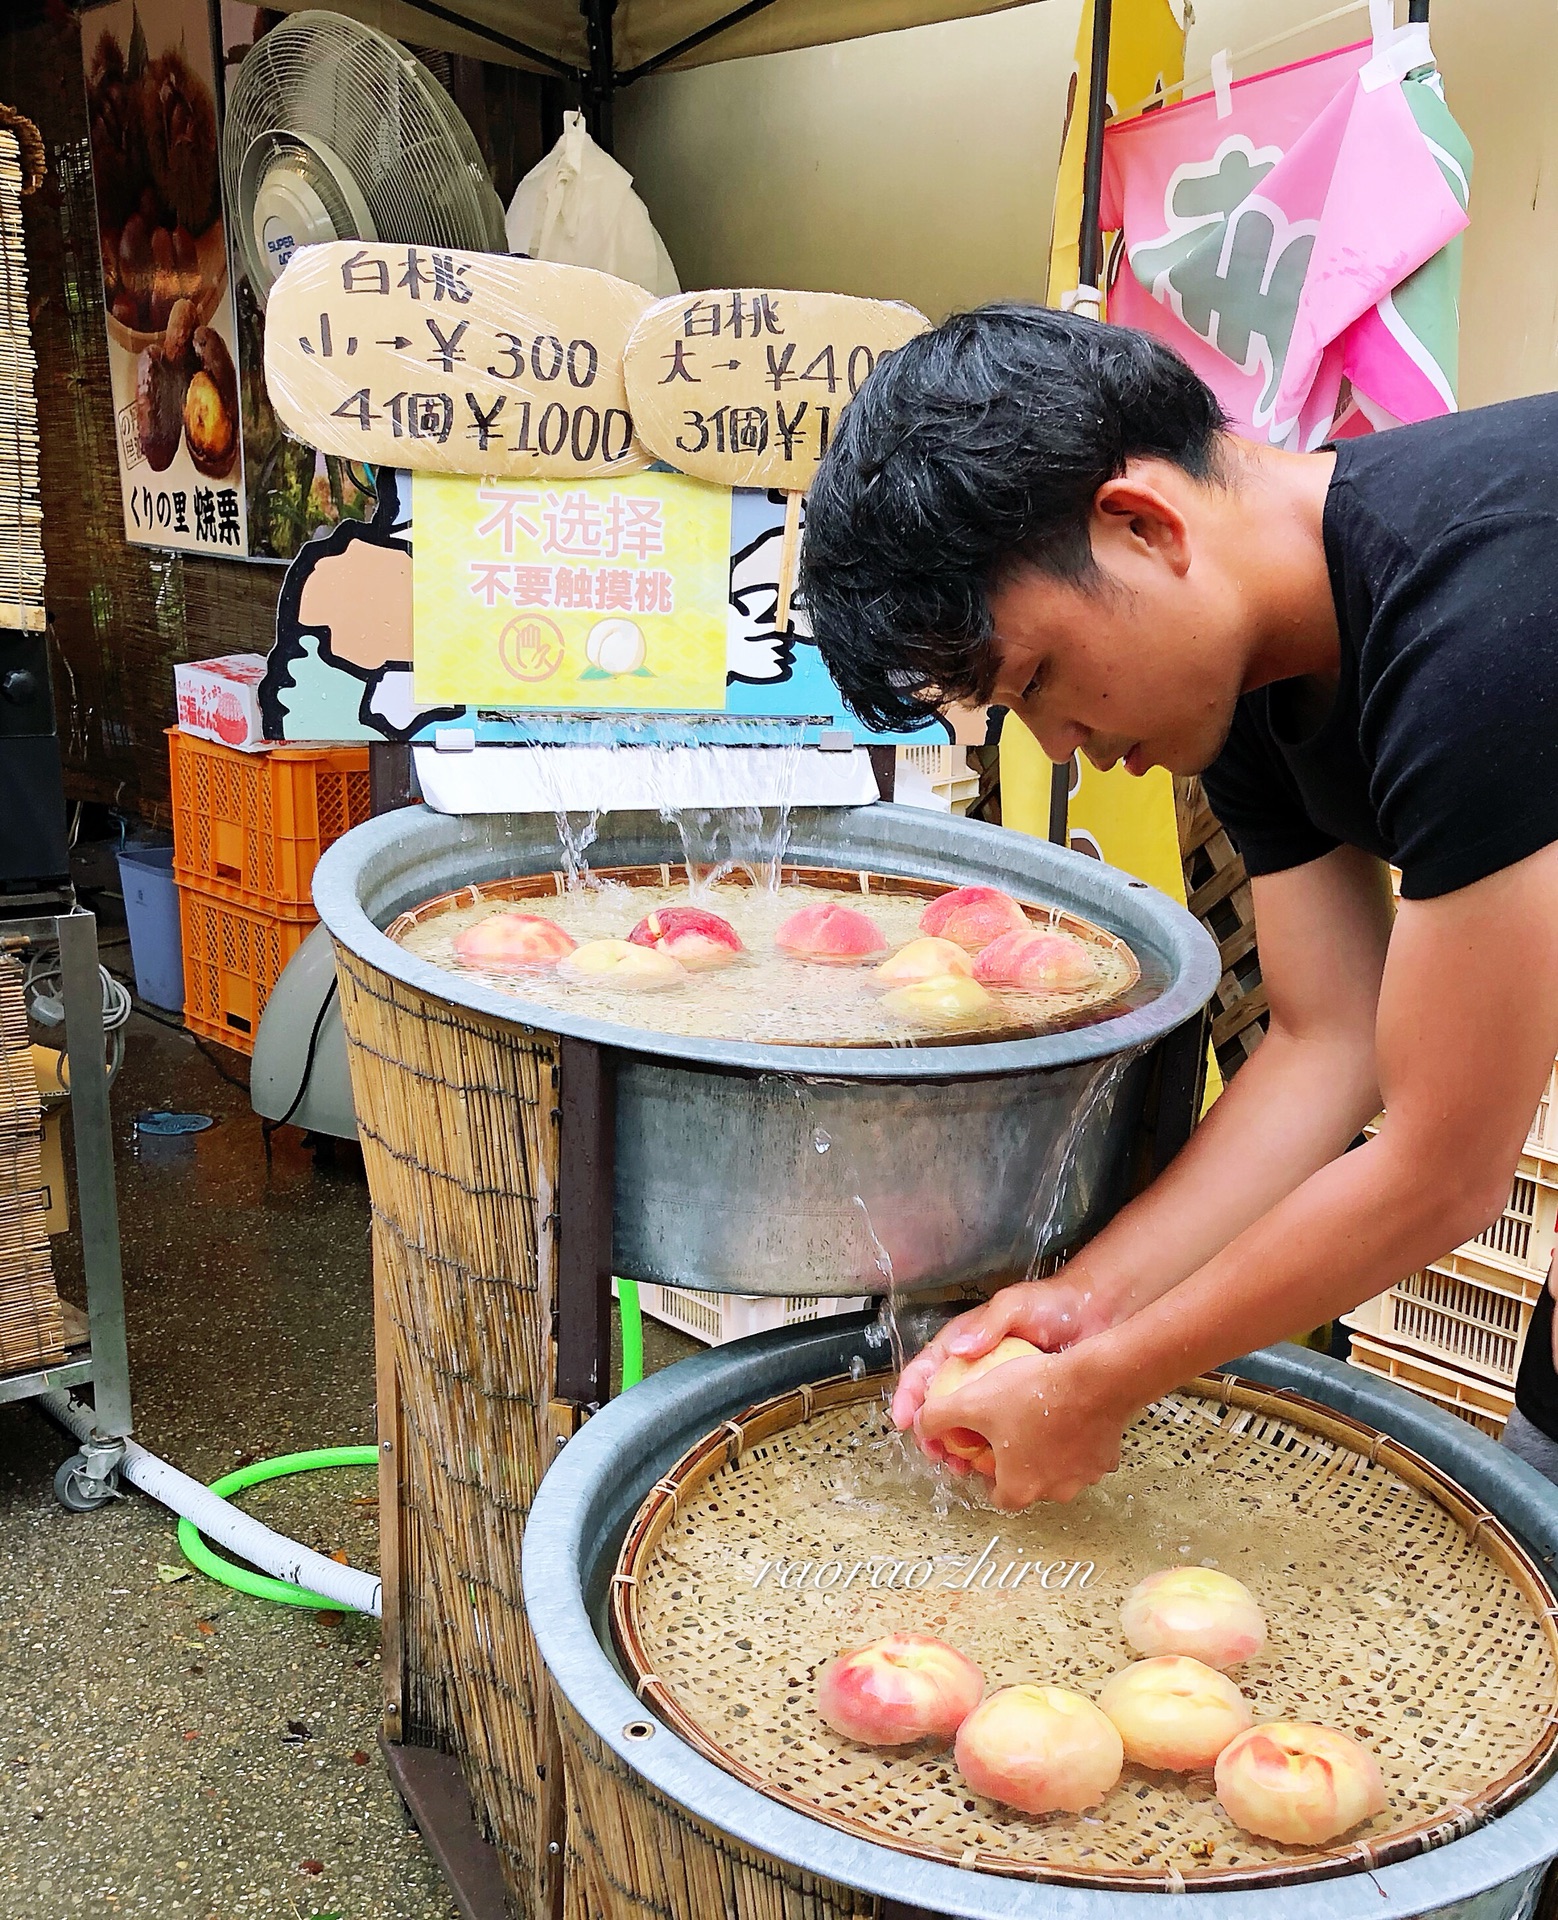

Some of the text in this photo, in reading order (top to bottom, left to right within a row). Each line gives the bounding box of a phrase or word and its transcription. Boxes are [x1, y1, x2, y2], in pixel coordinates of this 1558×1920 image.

[267, 235, 295, 253] SUPER
[341, 248, 474, 303] 白桃
[299, 313, 359, 357] 小
[684, 293, 785, 339] 白桃
[657, 340, 893, 394] 大 ¥40
[130, 486, 190, 534] くりの里
[478, 490, 663, 560] 不选择
[470, 563, 673, 613] 不要触摸桃
